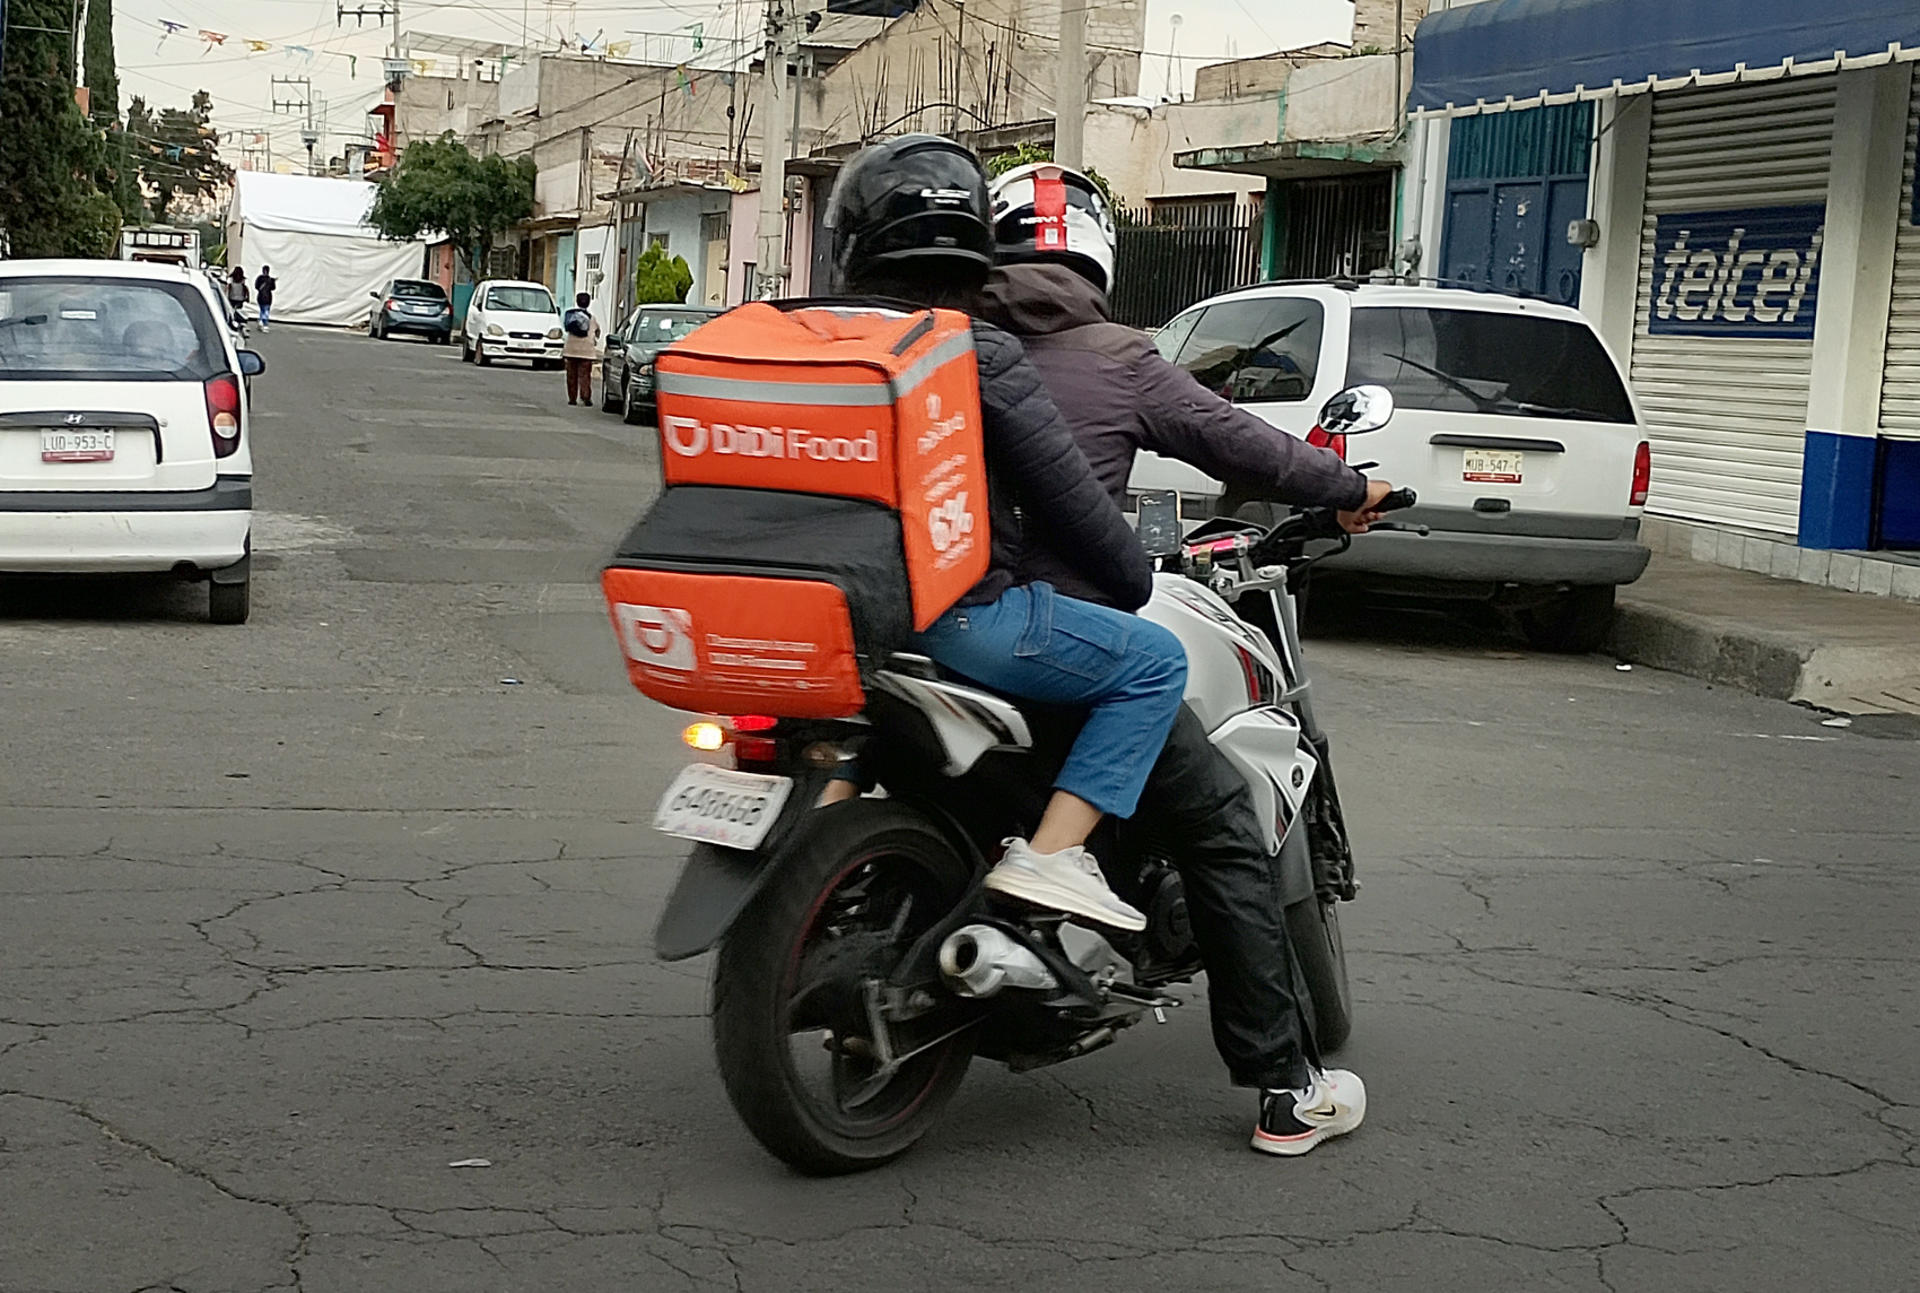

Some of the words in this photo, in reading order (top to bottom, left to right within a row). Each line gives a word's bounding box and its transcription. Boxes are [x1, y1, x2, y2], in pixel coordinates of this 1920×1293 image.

[1656, 225, 1826, 323] telcel
[43, 434, 112, 451] LUD-953-C
[711, 422, 786, 459] DiDi
[786, 428, 879, 462] Food
